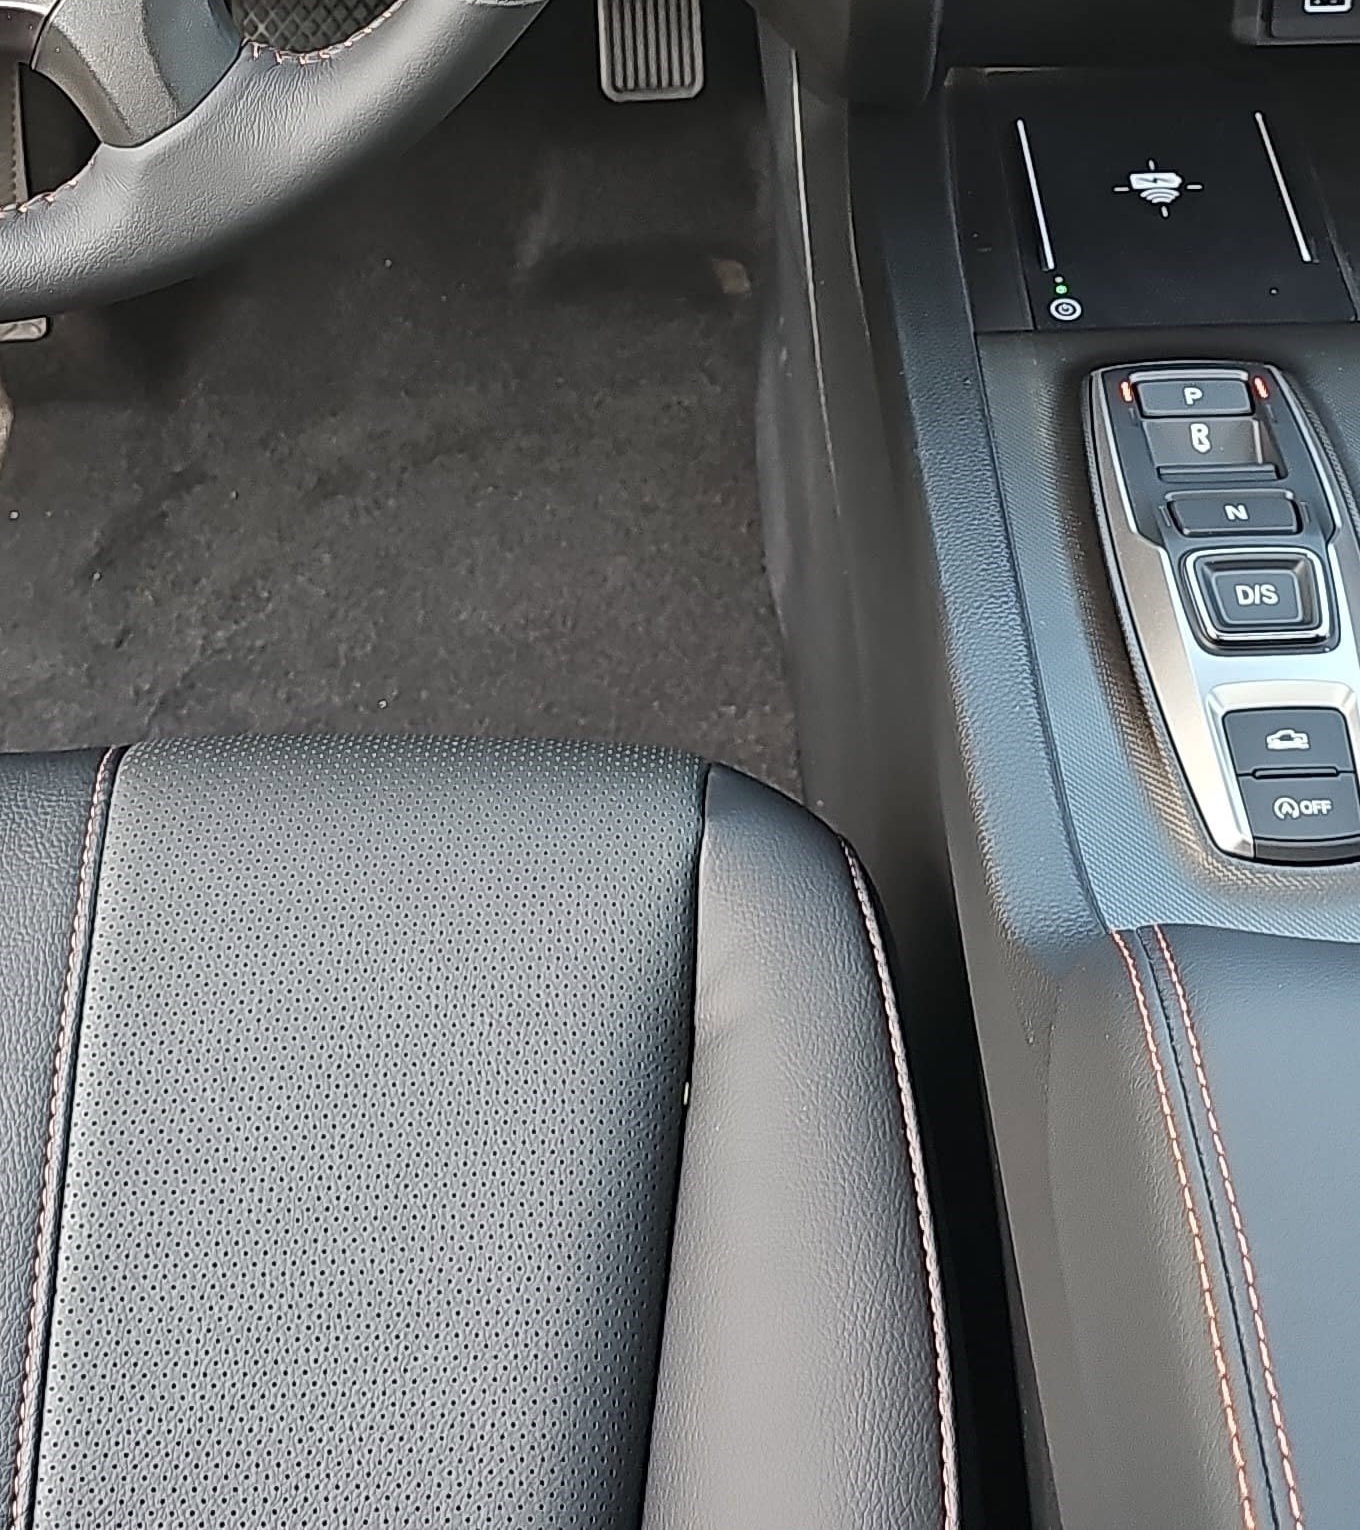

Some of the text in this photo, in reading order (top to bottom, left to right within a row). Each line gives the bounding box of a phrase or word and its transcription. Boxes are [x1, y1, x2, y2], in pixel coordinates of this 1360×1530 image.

[1183, 386, 1204, 406] P
[1224, 504, 1249, 521] N
[1236, 584, 1279, 606] D/S
[1300, 799, 1332, 815] OFF
